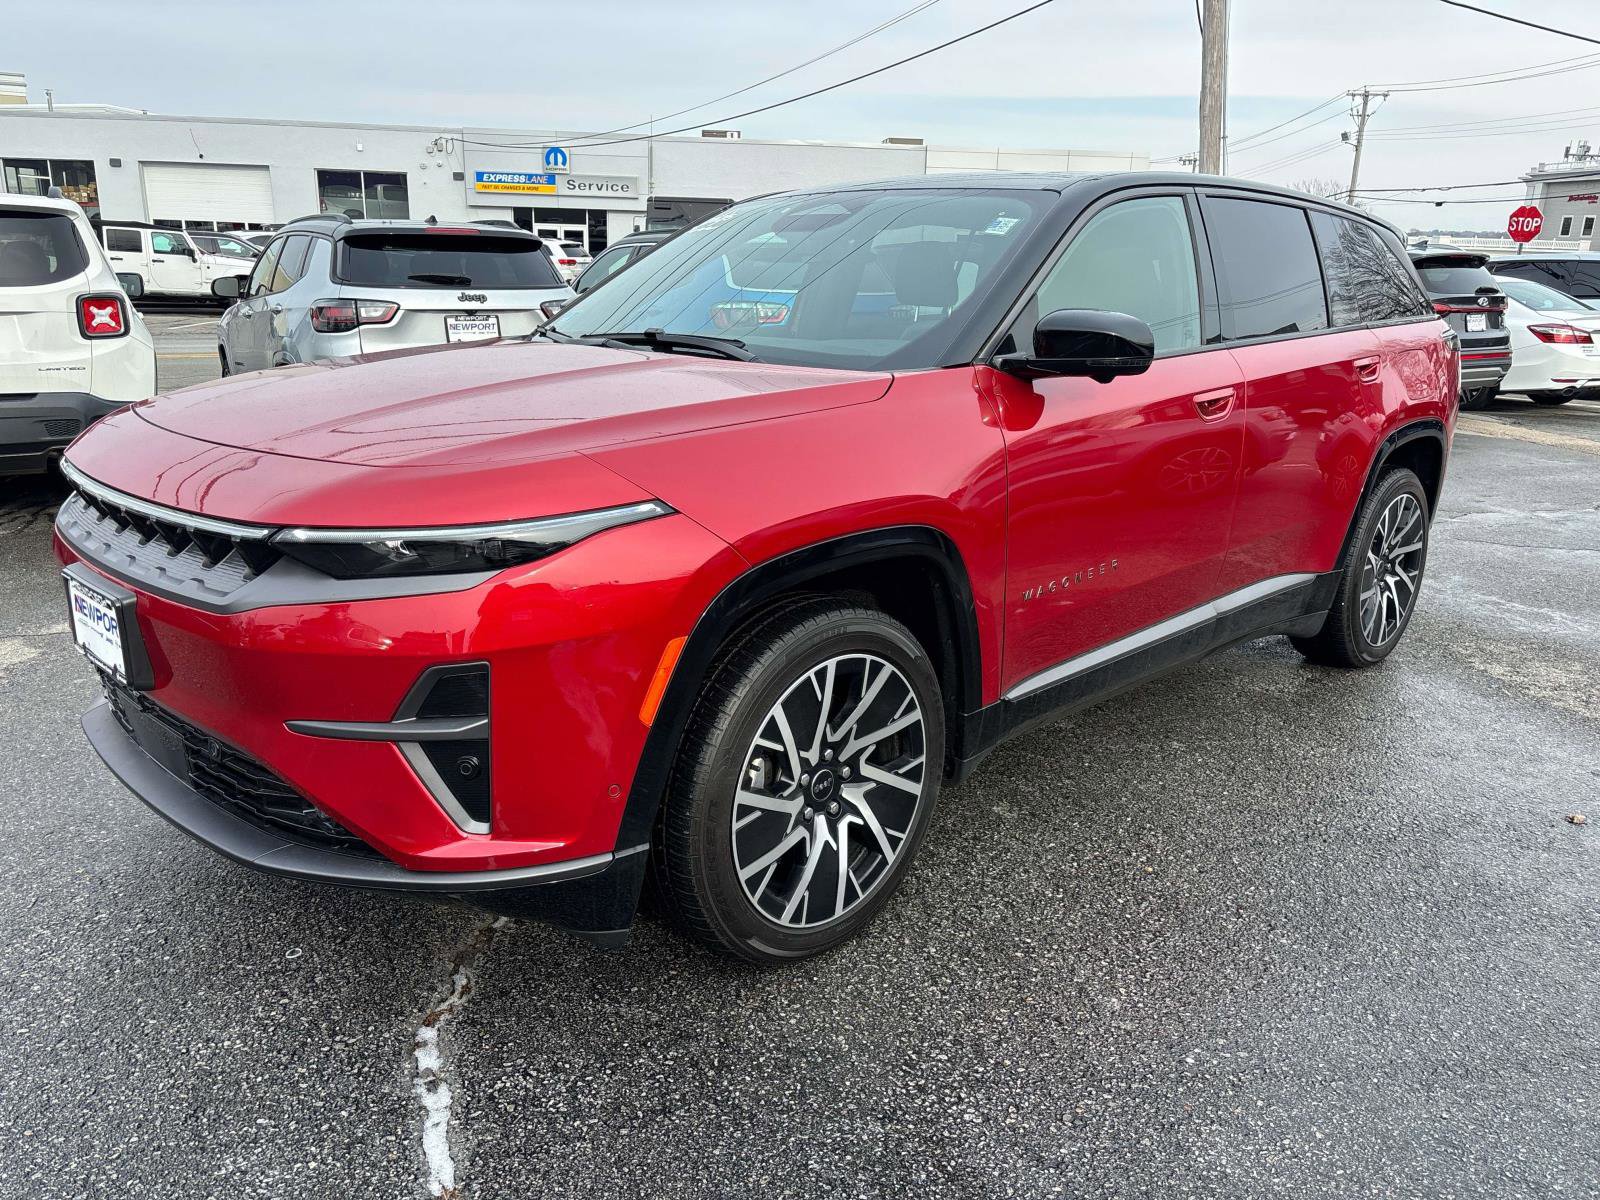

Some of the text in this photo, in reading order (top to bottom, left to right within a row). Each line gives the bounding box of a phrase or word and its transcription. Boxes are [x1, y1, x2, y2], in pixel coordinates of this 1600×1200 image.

[483, 173, 549, 184] EXPRESSLANE
[566, 179, 630, 192] Service
[1509, 217, 1541, 232] STOP
[457, 292, 488, 304] Jeep
[449, 323, 496, 331] NEWPORT
[1022, 559, 1118, 601] WAGONEER
[74, 594, 120, 639] NEWPOR
